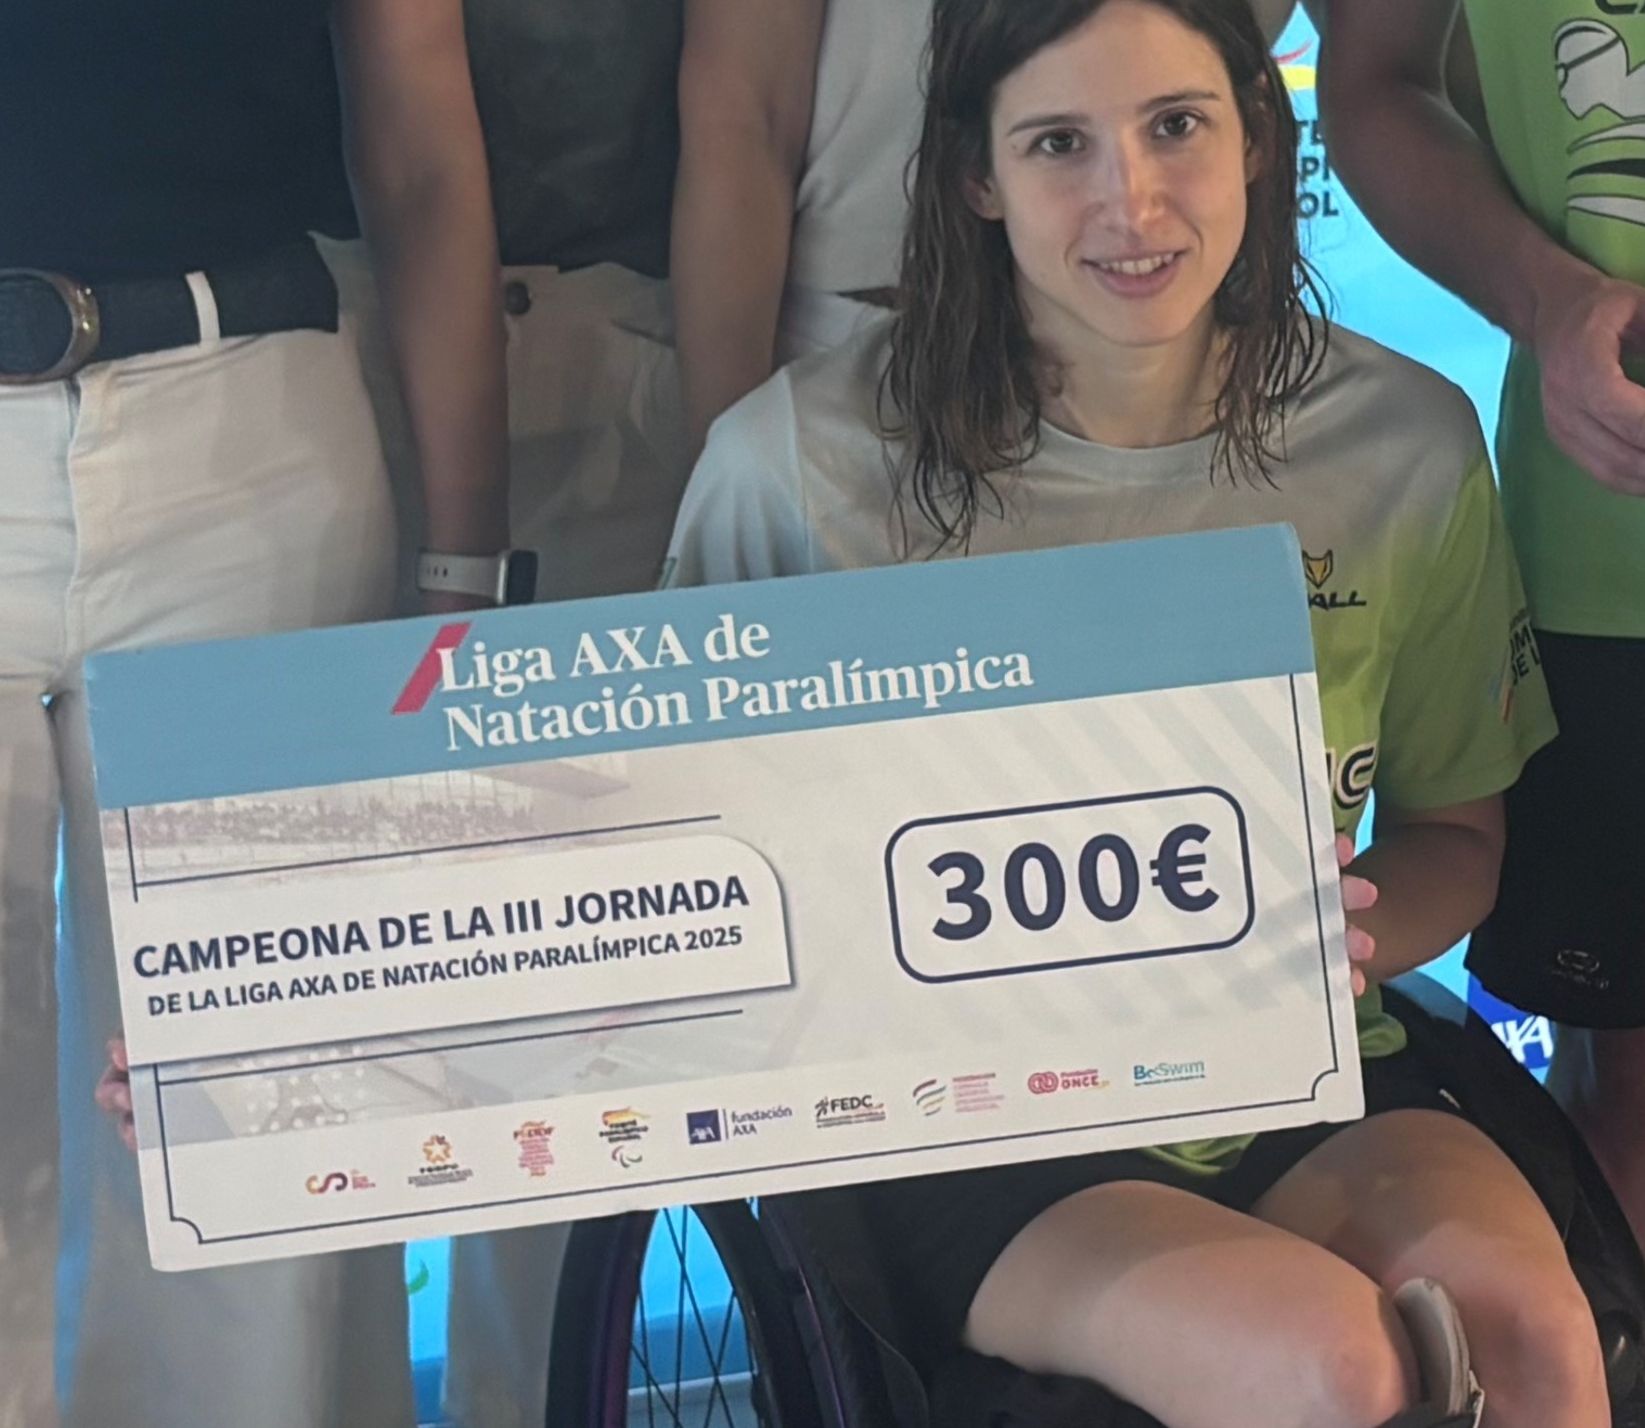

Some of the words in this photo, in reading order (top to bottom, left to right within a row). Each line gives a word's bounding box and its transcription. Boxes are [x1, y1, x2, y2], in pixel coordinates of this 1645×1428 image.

[434, 643, 557, 698] Liga
[569, 624, 693, 678] AXA
[703, 613, 771, 663] de
[443, 687, 691, 752] Natación
[706, 645, 1035, 723] Paralímpica
[132, 920, 369, 980] CAMPEONA
[378, 911, 433, 950] DE
[443, 904, 494, 942] LA
[503, 898, 543, 936] III
[553, 874, 750, 929] JORNADA
[926, 822, 1221, 942] 300€
[147, 992, 183, 1017] DE
[188, 988, 221, 1012] LA
[224, 980, 285, 1009] LIGA
[288, 976, 339, 1002] AXA
[342, 969, 377, 993] DE
[382, 947, 509, 989] NATACIÓN
[514, 931, 681, 972] PARALÍMPICA
[683, 924, 744, 952] 2025
[830, 1094, 874, 1114] FEDC
